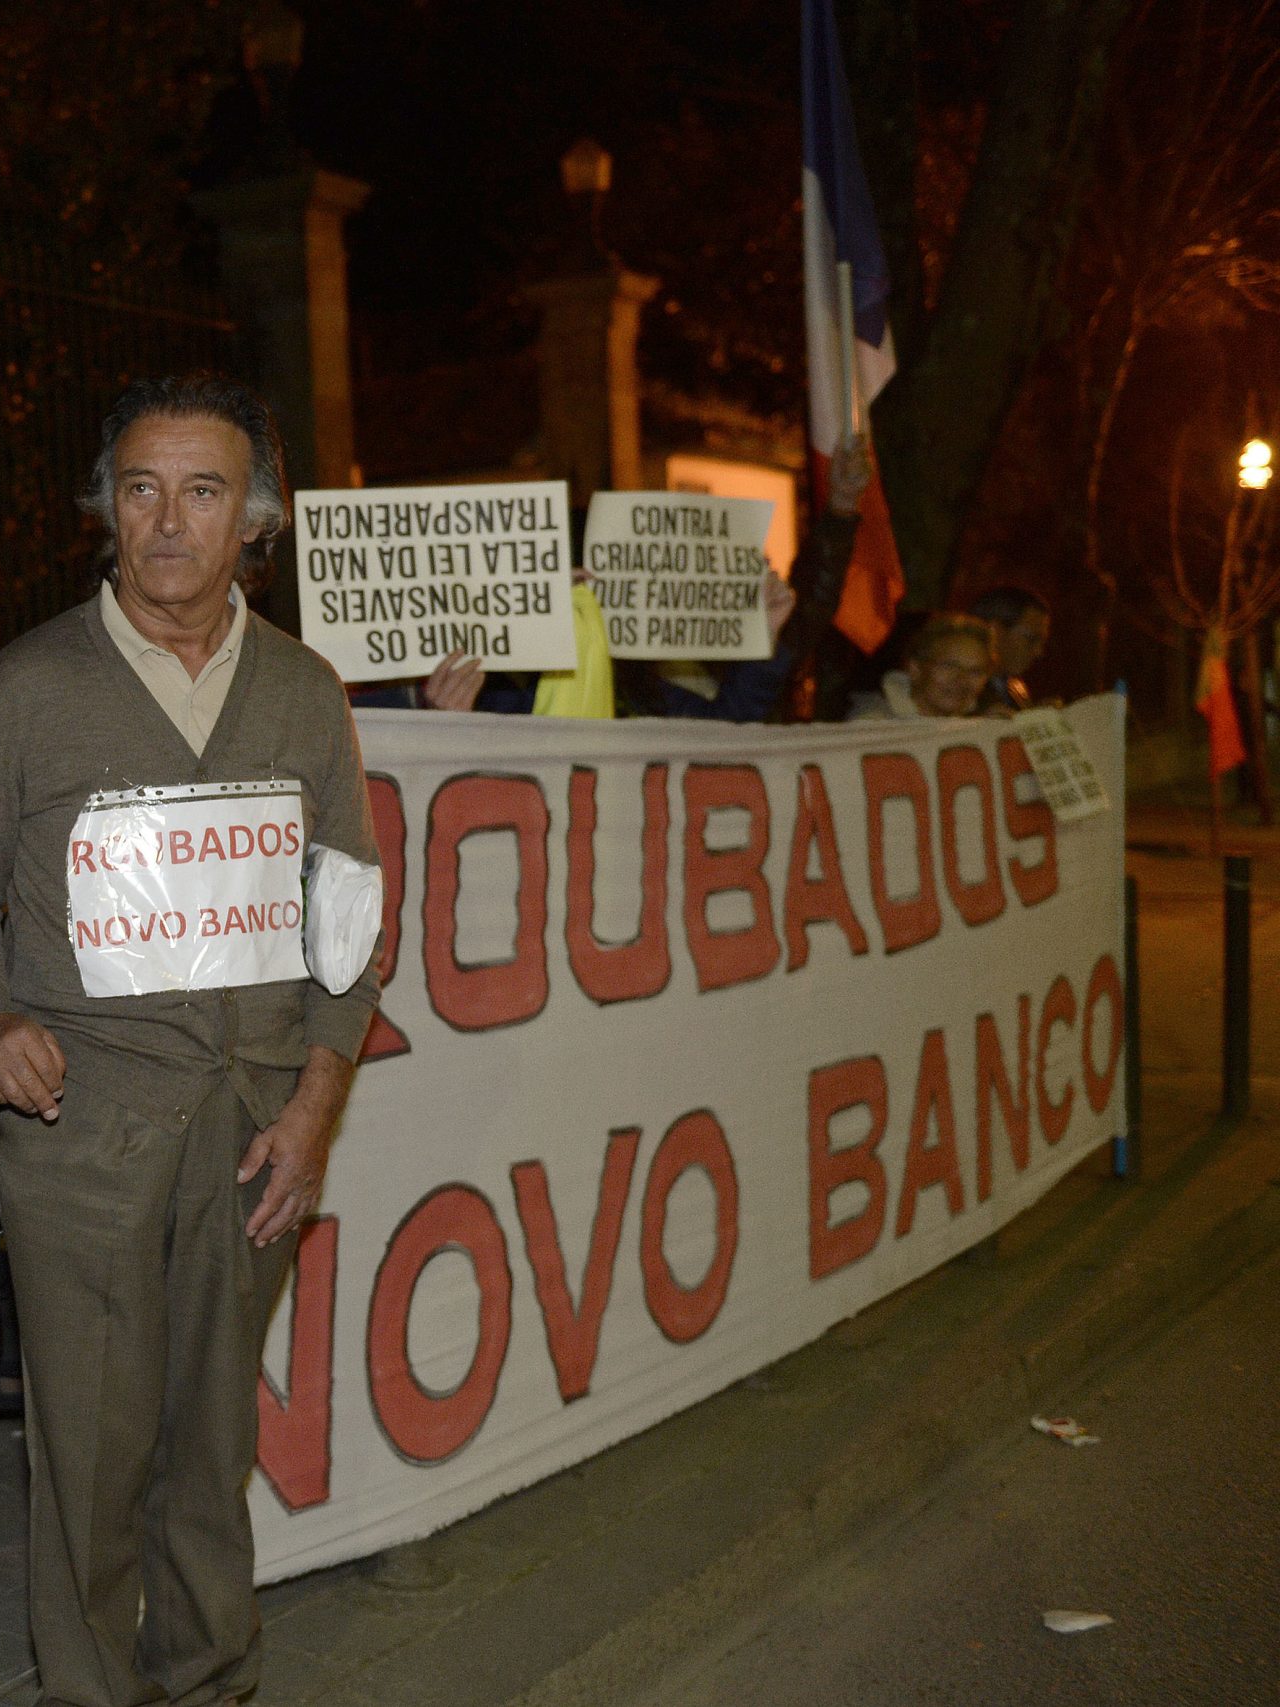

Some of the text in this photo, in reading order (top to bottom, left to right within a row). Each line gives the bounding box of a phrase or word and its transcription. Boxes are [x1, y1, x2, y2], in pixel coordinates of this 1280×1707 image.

[306, 497, 558, 544] TRANSPARÊNCIA
[632, 505, 730, 538] CONTRA A
[308, 539, 559, 586] PELA LEI DA NÃO
[591, 541, 763, 578] CRIAÇÃO DE LEIS
[322, 581, 552, 625] RESPONSÁVEIS
[593, 579, 760, 612] QUE FAVORECEM
[366, 623, 510, 663] PUNIR OS
[608, 616, 743, 647] OS PARTIDOS
[76, 900, 300, 949] NOVO BANCO
[807, 955, 1122, 1281] BANCO
